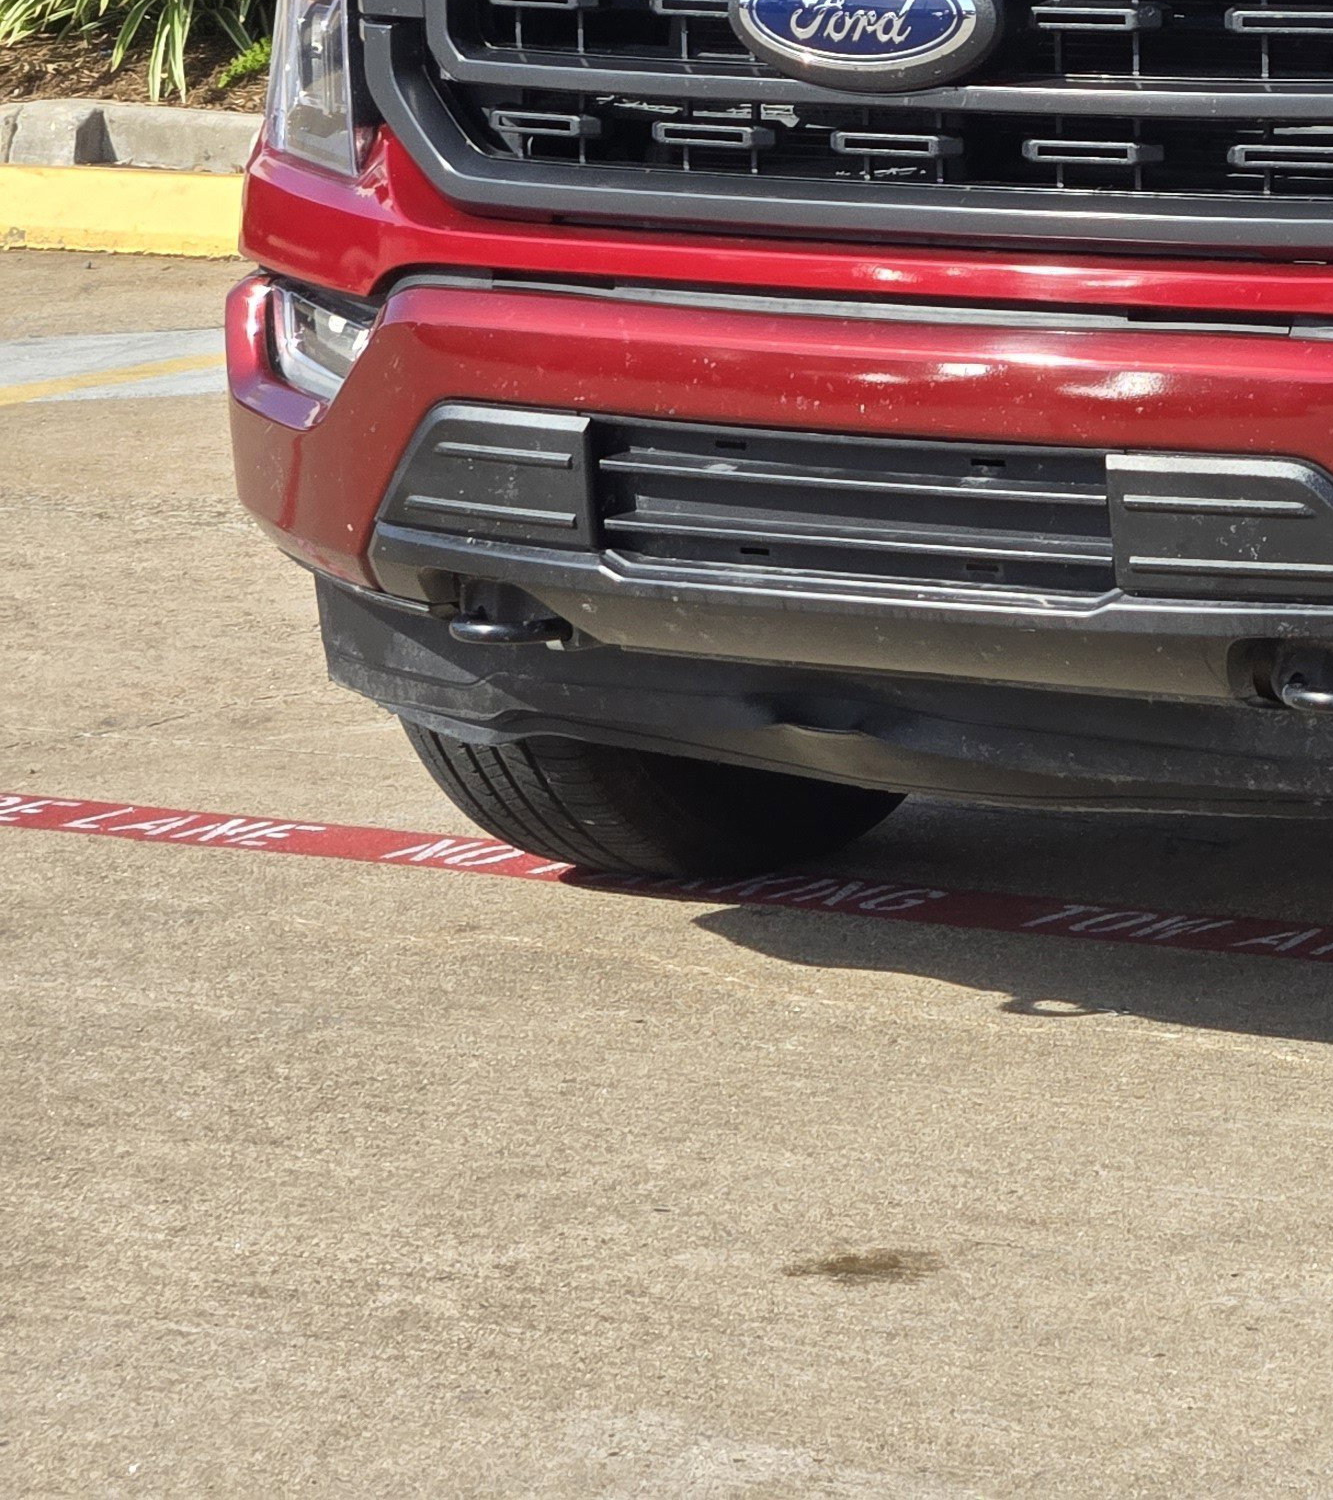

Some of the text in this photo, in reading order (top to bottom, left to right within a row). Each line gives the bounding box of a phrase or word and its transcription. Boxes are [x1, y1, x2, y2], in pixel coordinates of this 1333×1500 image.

[61, 806, 327, 847] LANE
[380, 838, 526, 867] NO
[1020, 904, 1235, 940] TOW
